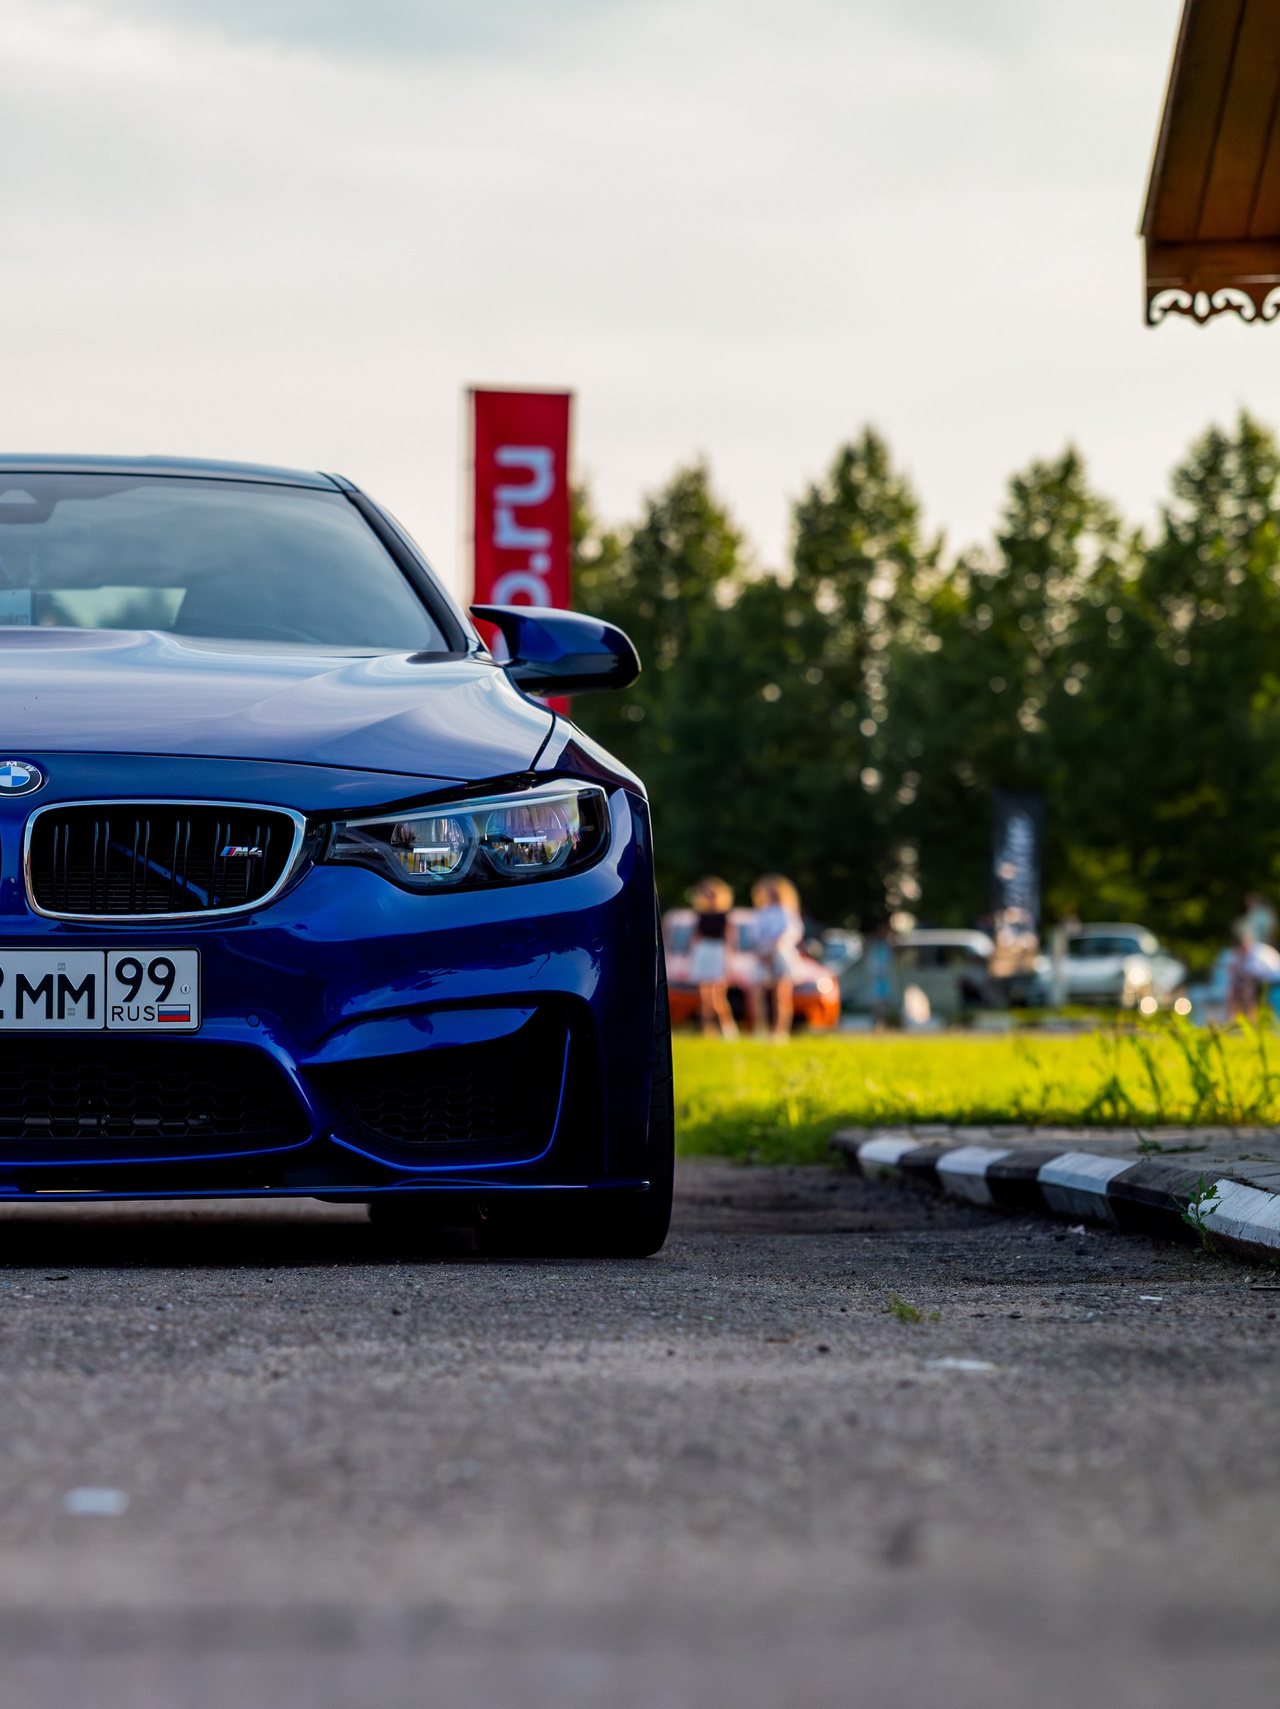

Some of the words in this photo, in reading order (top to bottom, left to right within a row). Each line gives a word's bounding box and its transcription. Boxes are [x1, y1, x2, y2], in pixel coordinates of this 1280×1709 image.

[490, 445, 555, 610] o.ru
[114, 957, 176, 1002] 99
[111, 1005, 155, 1021] RUS
